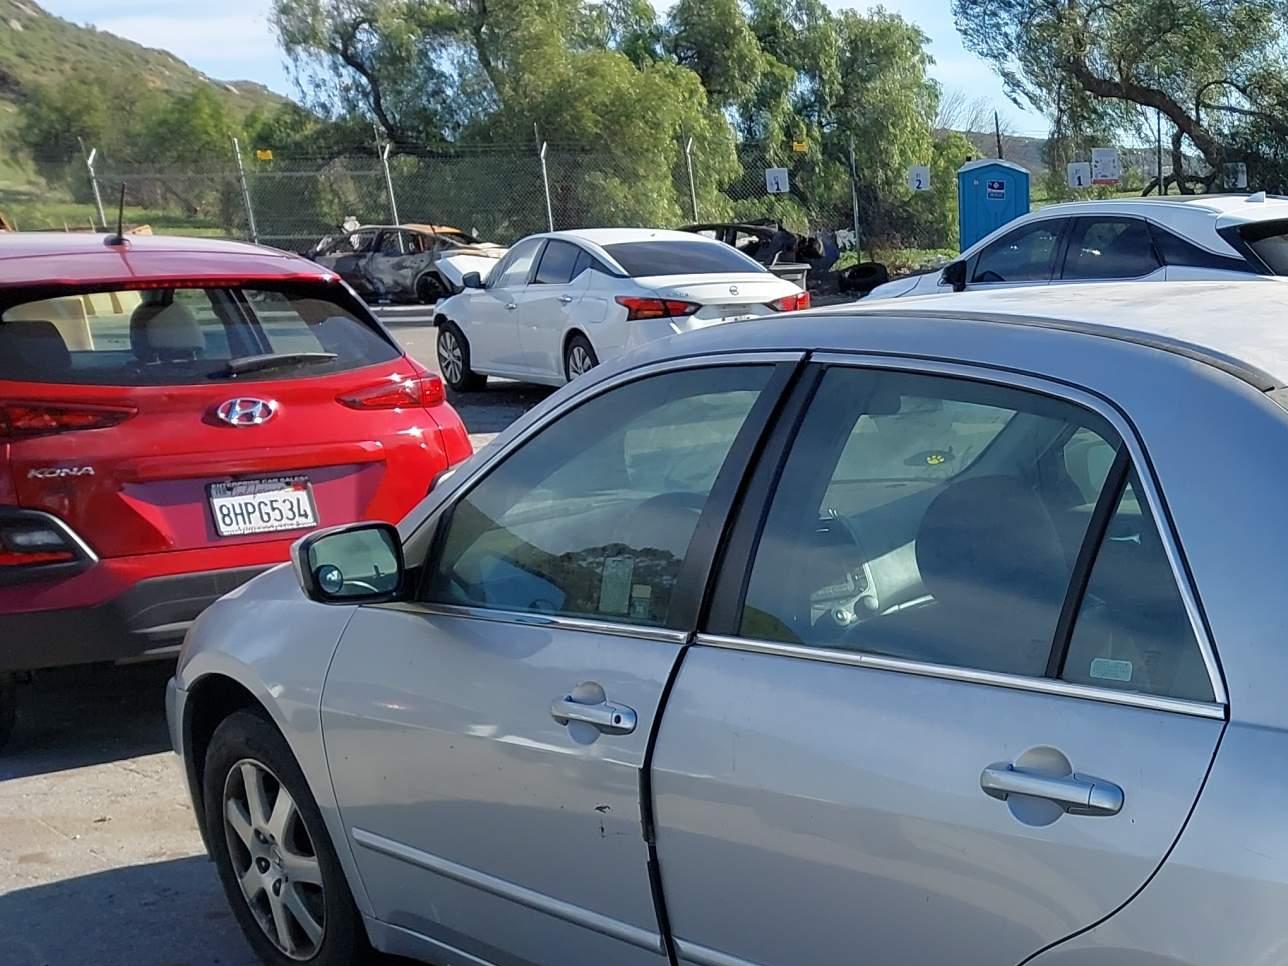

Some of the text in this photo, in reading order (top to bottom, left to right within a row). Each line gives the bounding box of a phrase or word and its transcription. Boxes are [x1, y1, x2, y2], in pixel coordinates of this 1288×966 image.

[915, 178, 922, 190] 2
[1076, 175, 1083, 186] 1
[27, 466, 96, 479] KONA
[219, 497, 309, 527] 8HPG534
